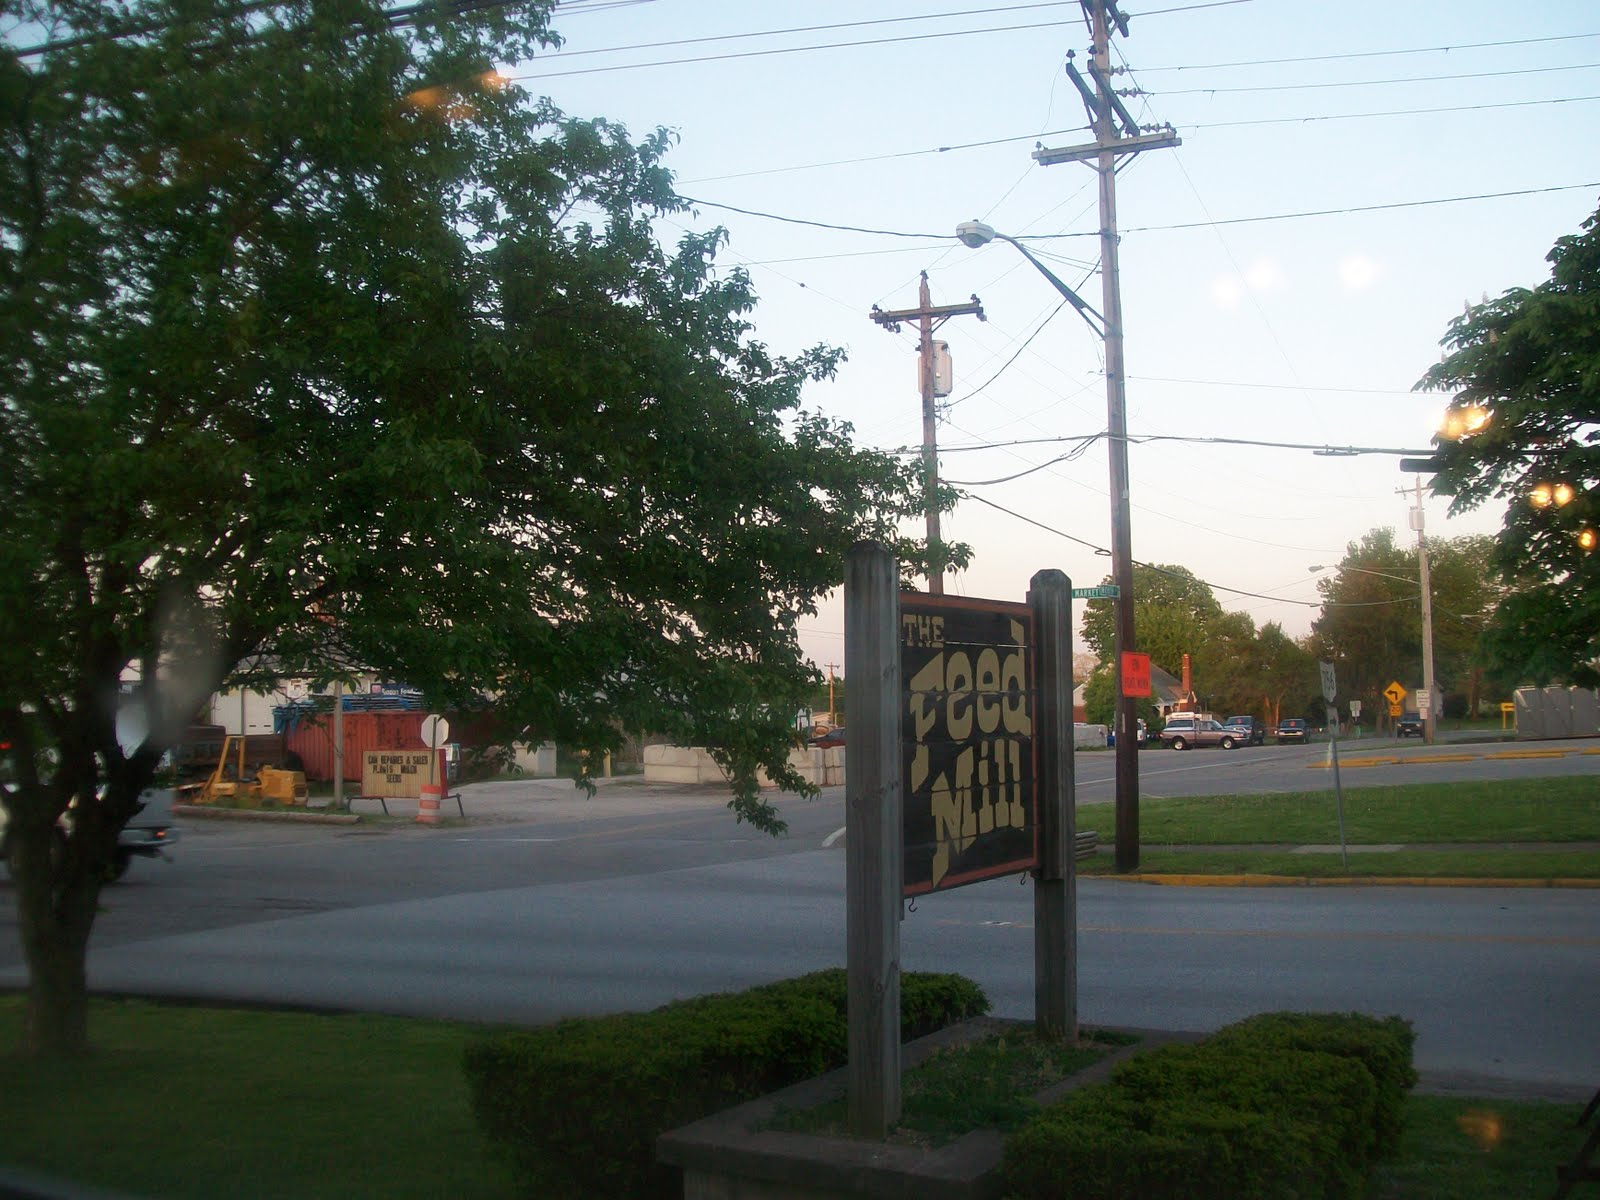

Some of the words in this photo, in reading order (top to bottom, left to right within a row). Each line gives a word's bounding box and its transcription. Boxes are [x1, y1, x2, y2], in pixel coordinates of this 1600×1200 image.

[1074, 588, 1099, 598] MARKET
[902, 614, 945, 648] THE
[910, 618, 1032, 794] Feed
[1391, 706, 1401, 714] 20
[412, 755, 428, 765] SALES
[372, 764, 394, 774] PLANTS
[931, 738, 1025, 889] Mill
